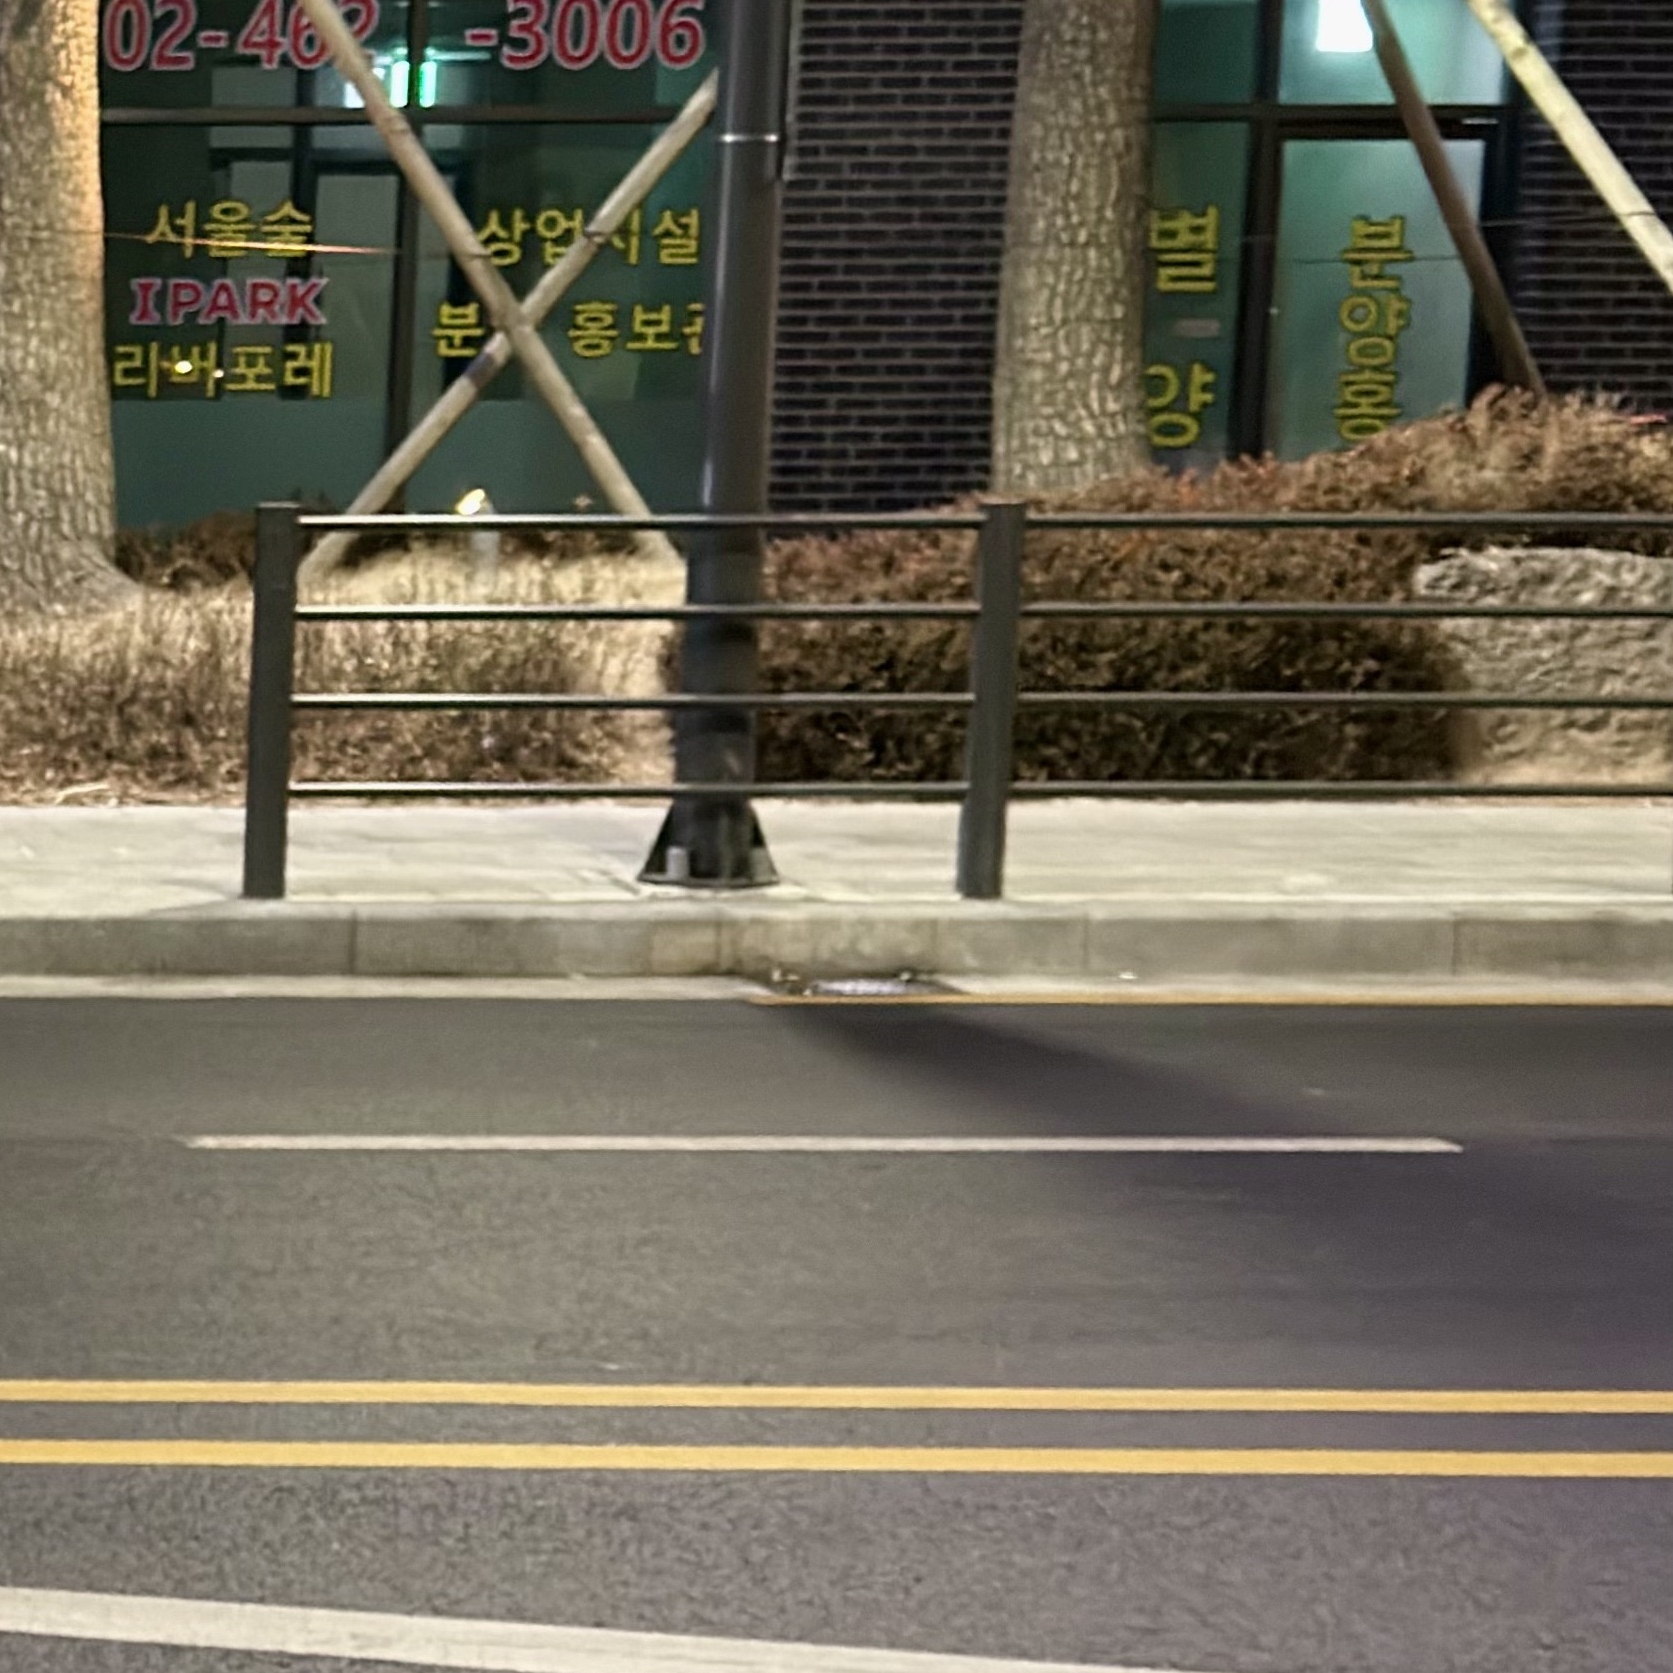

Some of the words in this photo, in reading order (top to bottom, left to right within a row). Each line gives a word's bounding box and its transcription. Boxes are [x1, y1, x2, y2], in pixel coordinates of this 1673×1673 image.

[144, 199, 314, 258] 서울숲
[128, 276, 330, 326] IPARK
[112, 341, 333, 398] 리버포레
